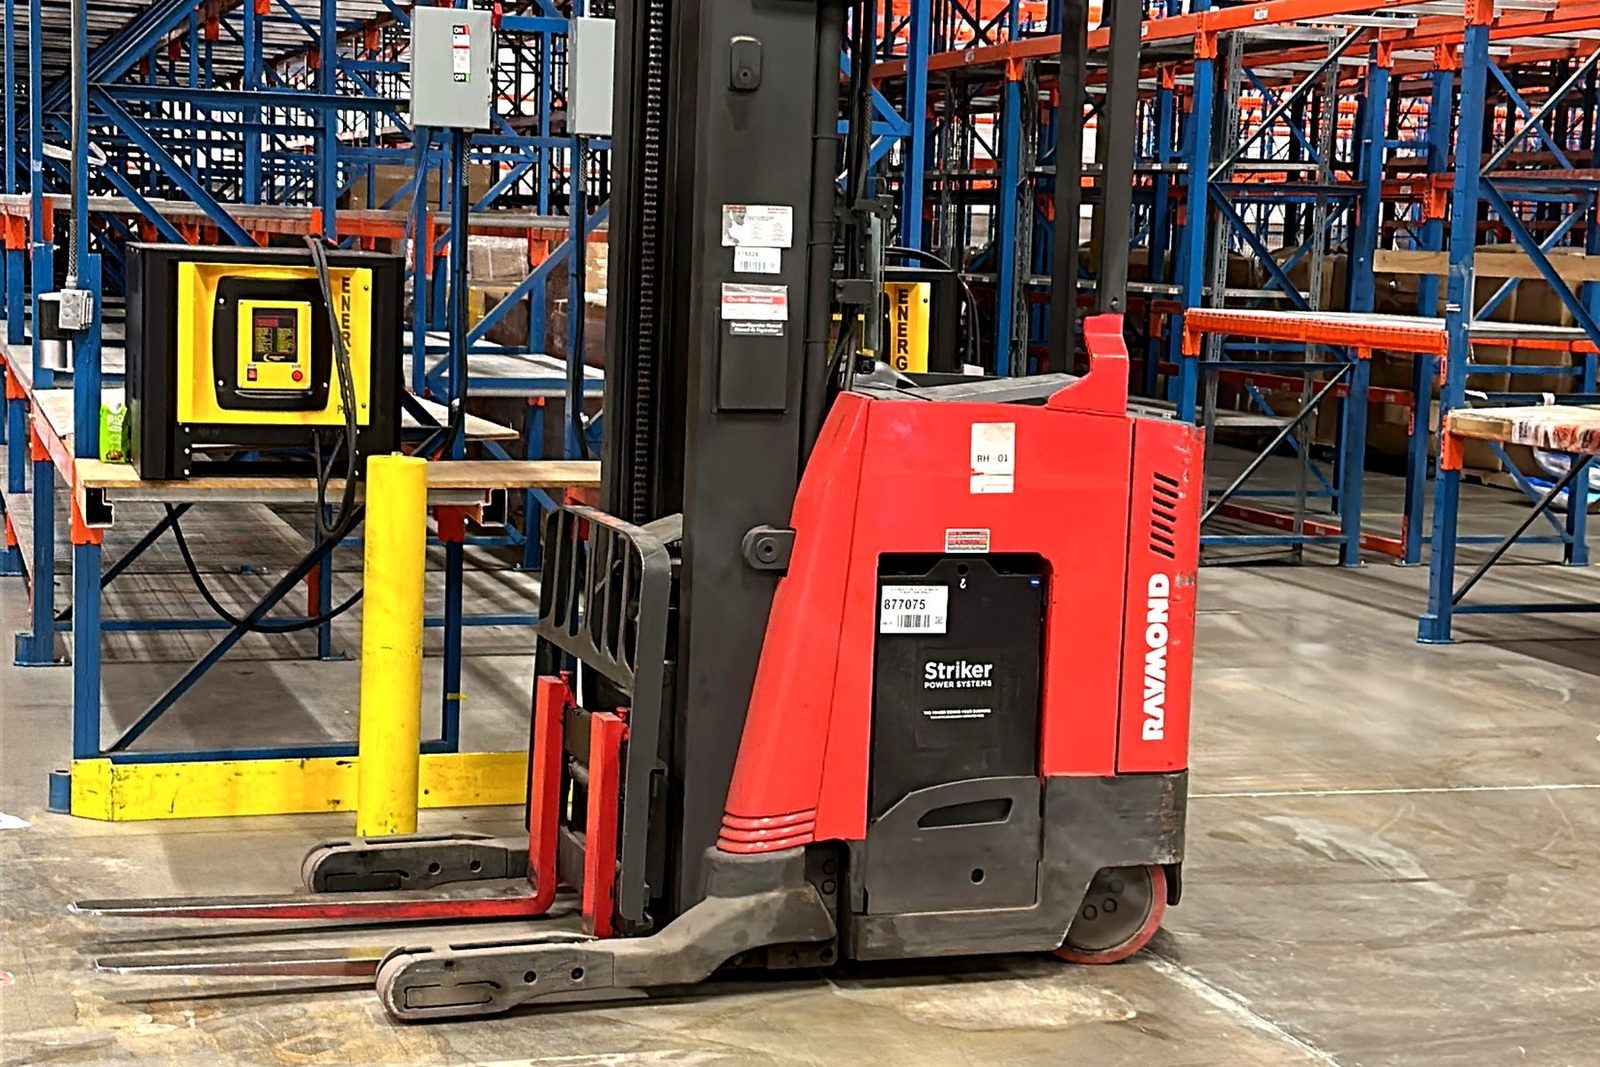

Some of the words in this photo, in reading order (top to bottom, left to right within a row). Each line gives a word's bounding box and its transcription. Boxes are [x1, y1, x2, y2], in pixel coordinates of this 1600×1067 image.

[977, 454, 990, 463] RH
[998, 453, 1008, 463] 01
[884, 598, 926, 610] 877075
[1142, 573, 1170, 741] RAYMOND
[924, 660, 993, 680] Striker
[924, 681, 954, 689] POWER
[956, 680, 992, 688] SYSTEMS
